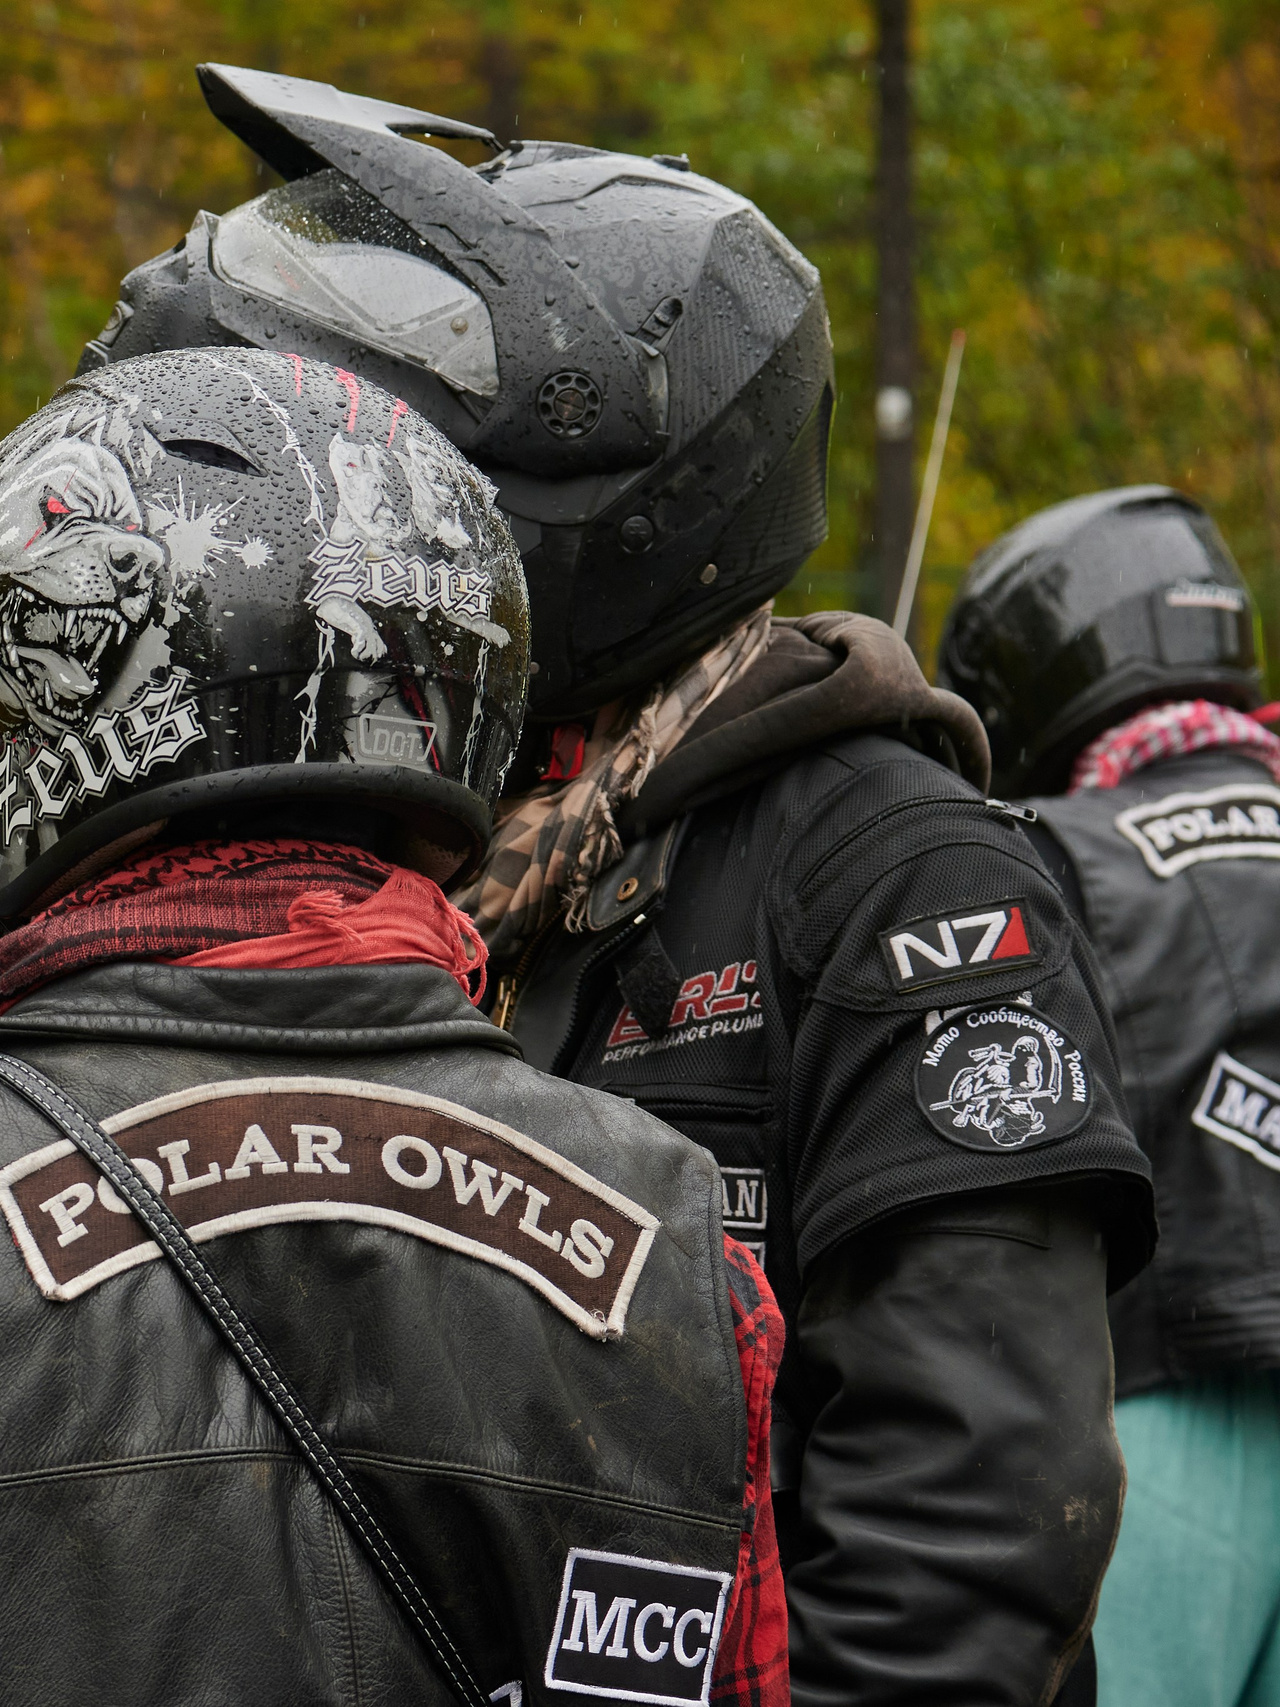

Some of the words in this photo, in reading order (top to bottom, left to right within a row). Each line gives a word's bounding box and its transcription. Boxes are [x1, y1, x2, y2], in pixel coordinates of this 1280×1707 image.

[304, 536, 492, 620] Zeus
[373, 727, 422, 759] DOT
[1142, 805, 1280, 851] POLAR
[889, 910, 1007, 980] N7
[922, 1026, 960, 1067] Мото
[966, 1006, 1065, 1047] Сообщество
[1064, 1050, 1087, 1103] России
[38, 1124, 350, 1248] POLAR
[381, 1135, 615, 1279] OWLS
[561, 1589, 714, 1668] MCC
